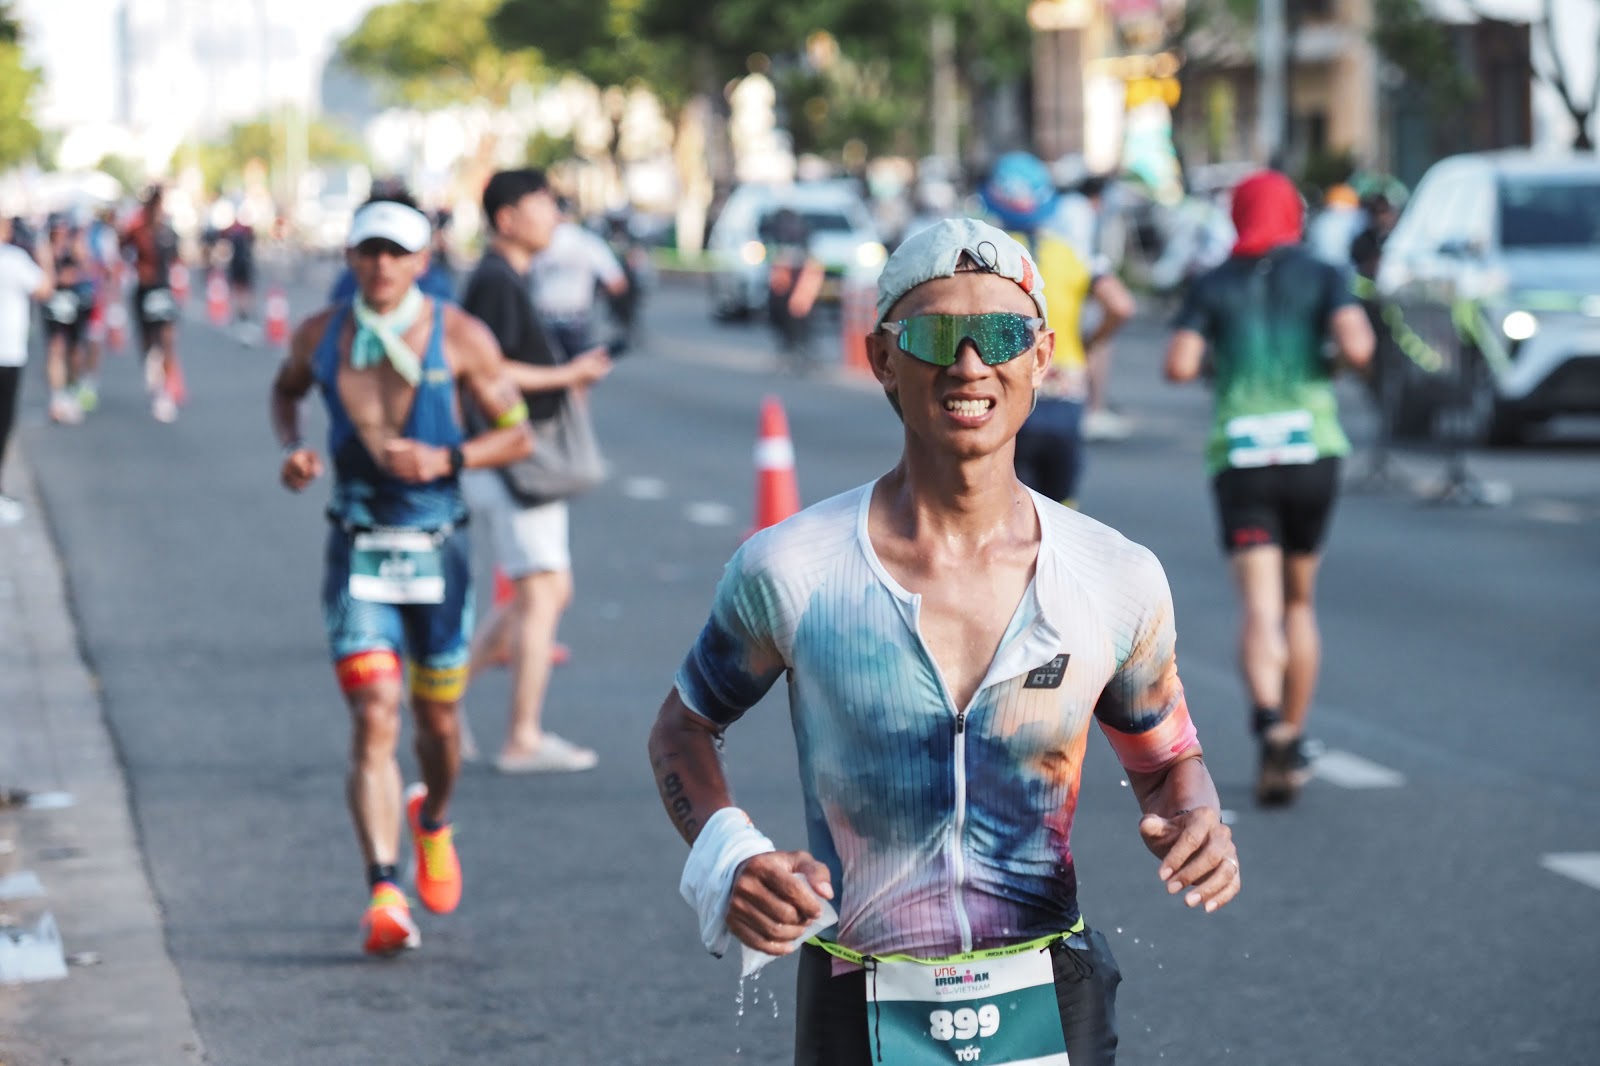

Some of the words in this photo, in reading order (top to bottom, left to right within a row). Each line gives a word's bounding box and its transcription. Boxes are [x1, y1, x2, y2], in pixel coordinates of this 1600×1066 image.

[935, 970, 989, 986] IRONMAN
[953, 984, 990, 994] VIETNAM
[929, 1003, 1000, 1041] 899
[955, 1044, 981, 1062] TỐT
